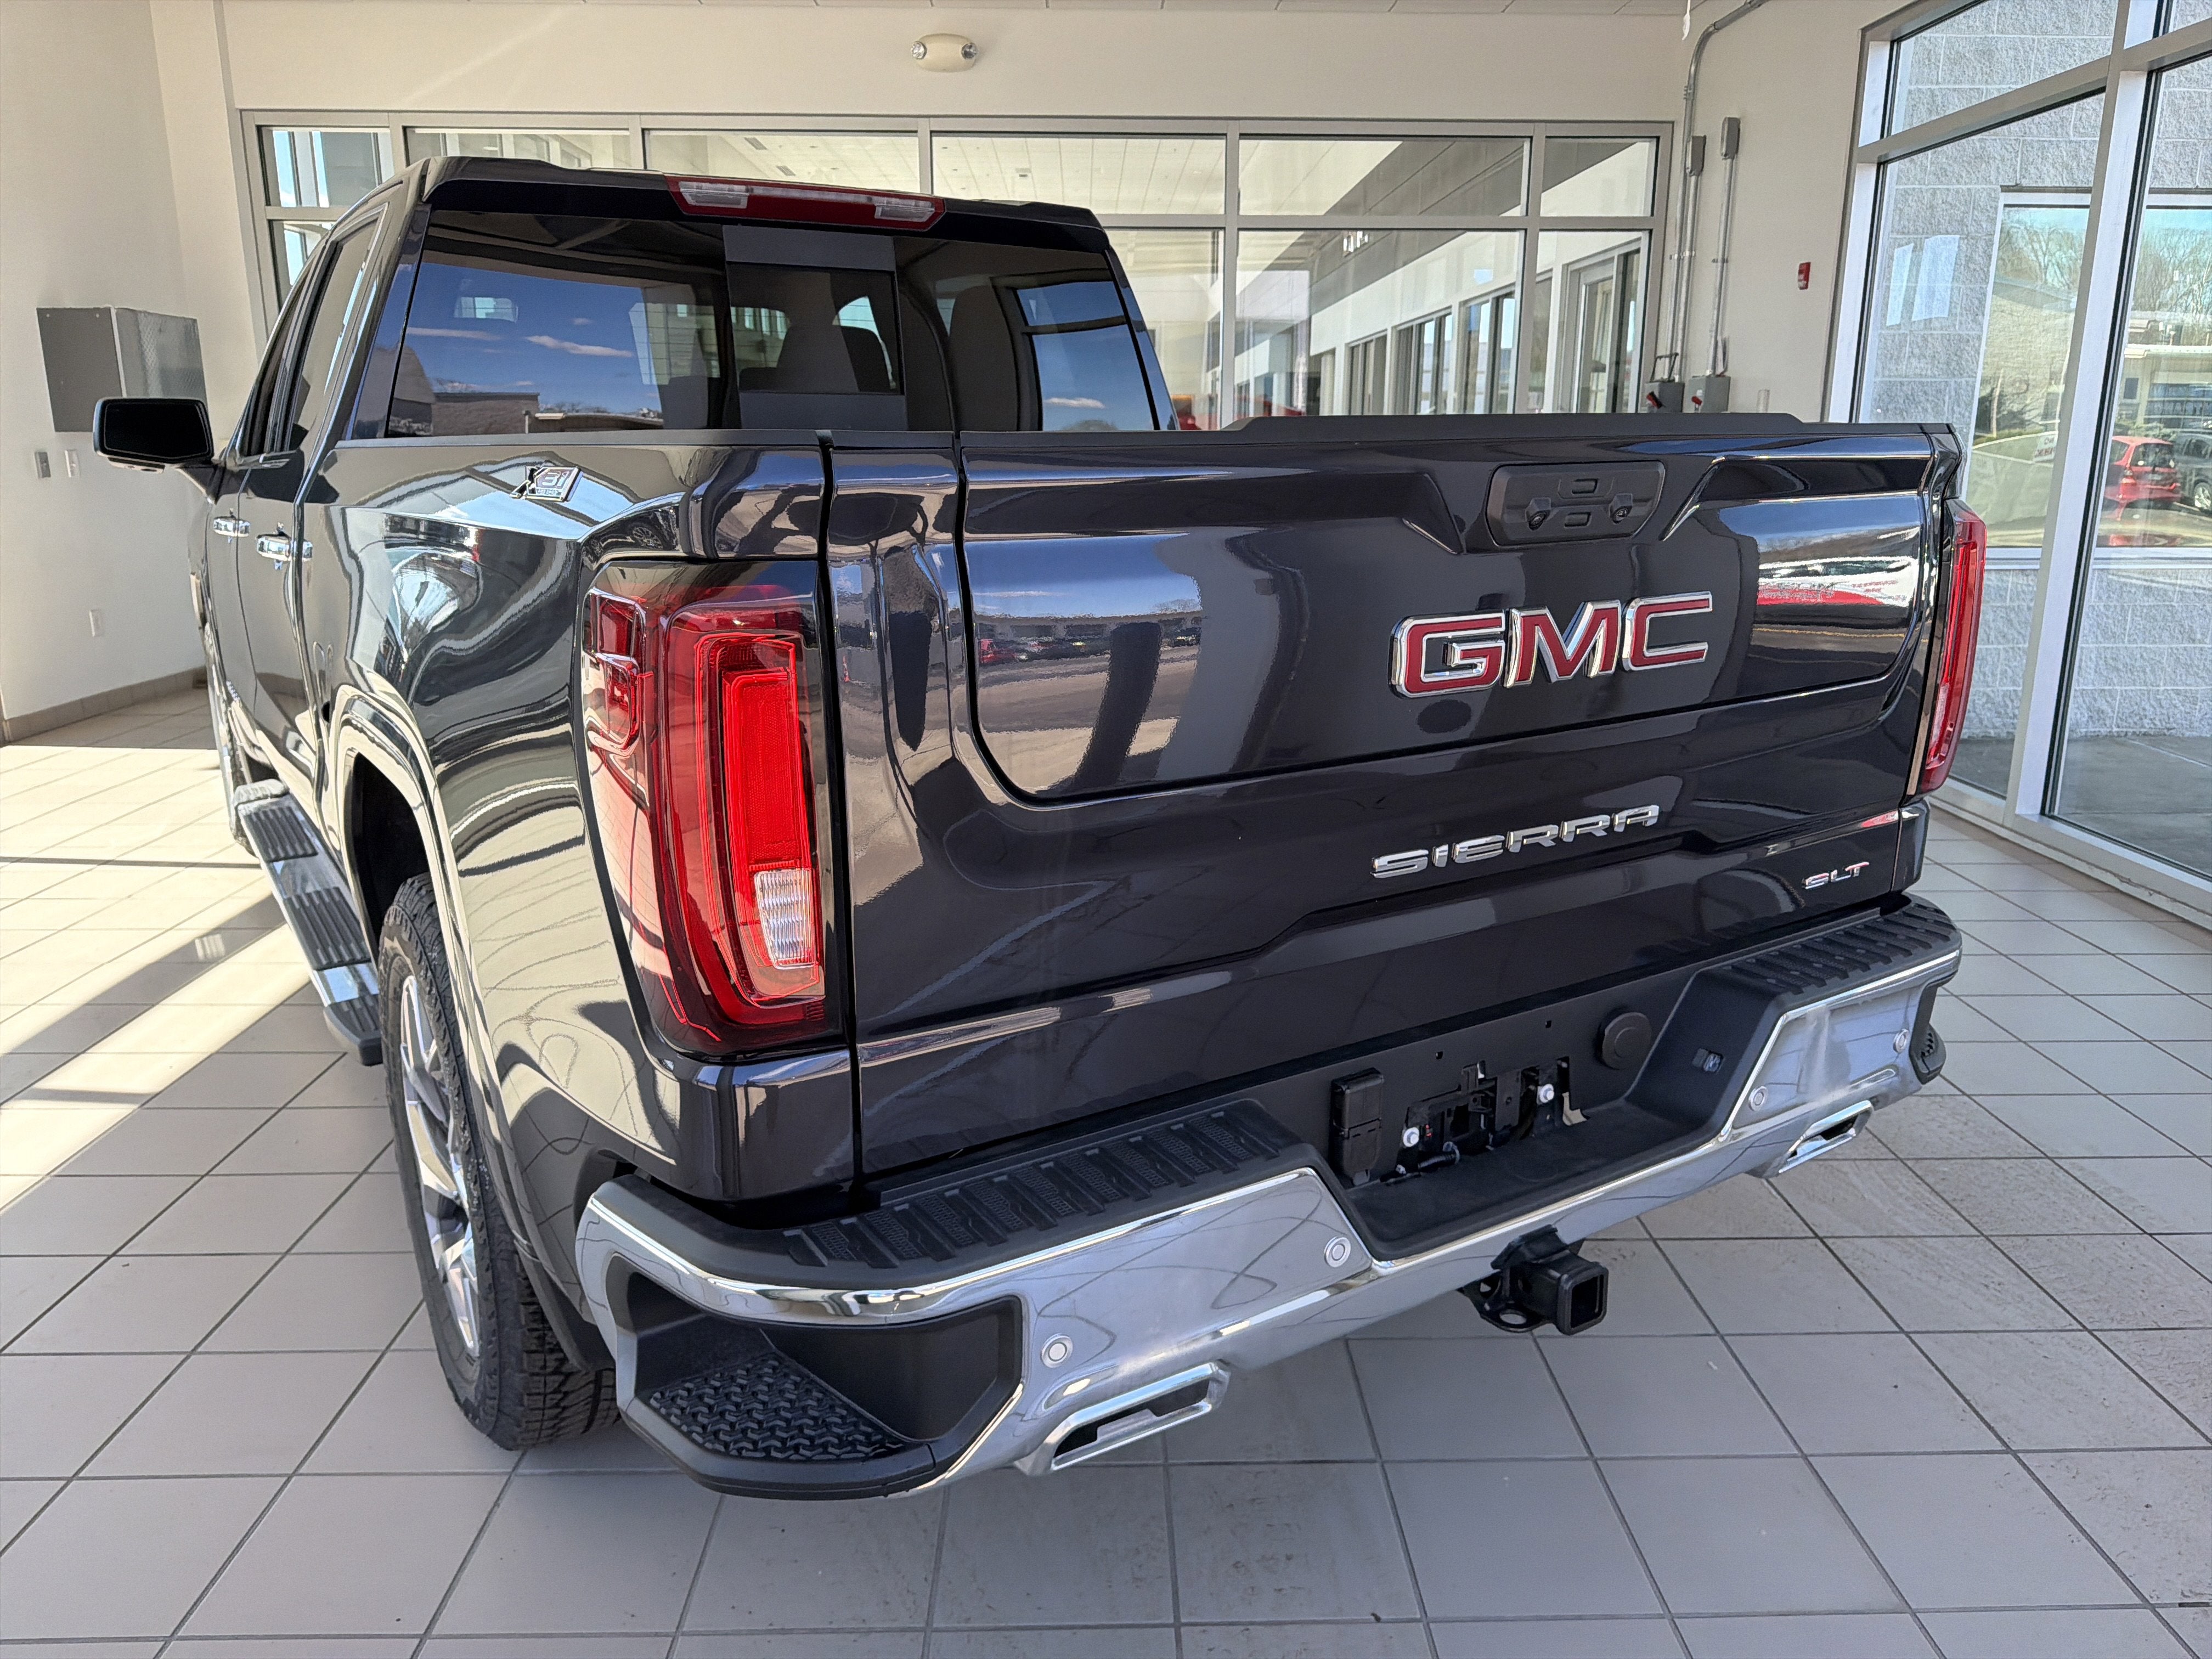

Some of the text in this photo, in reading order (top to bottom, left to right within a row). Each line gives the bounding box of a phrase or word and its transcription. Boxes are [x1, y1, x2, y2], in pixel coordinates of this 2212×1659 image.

[1388, 591, 1713, 698] GMC
[1370, 805, 1660, 878] SIERRA
[1802, 861, 1870, 889] SLT
